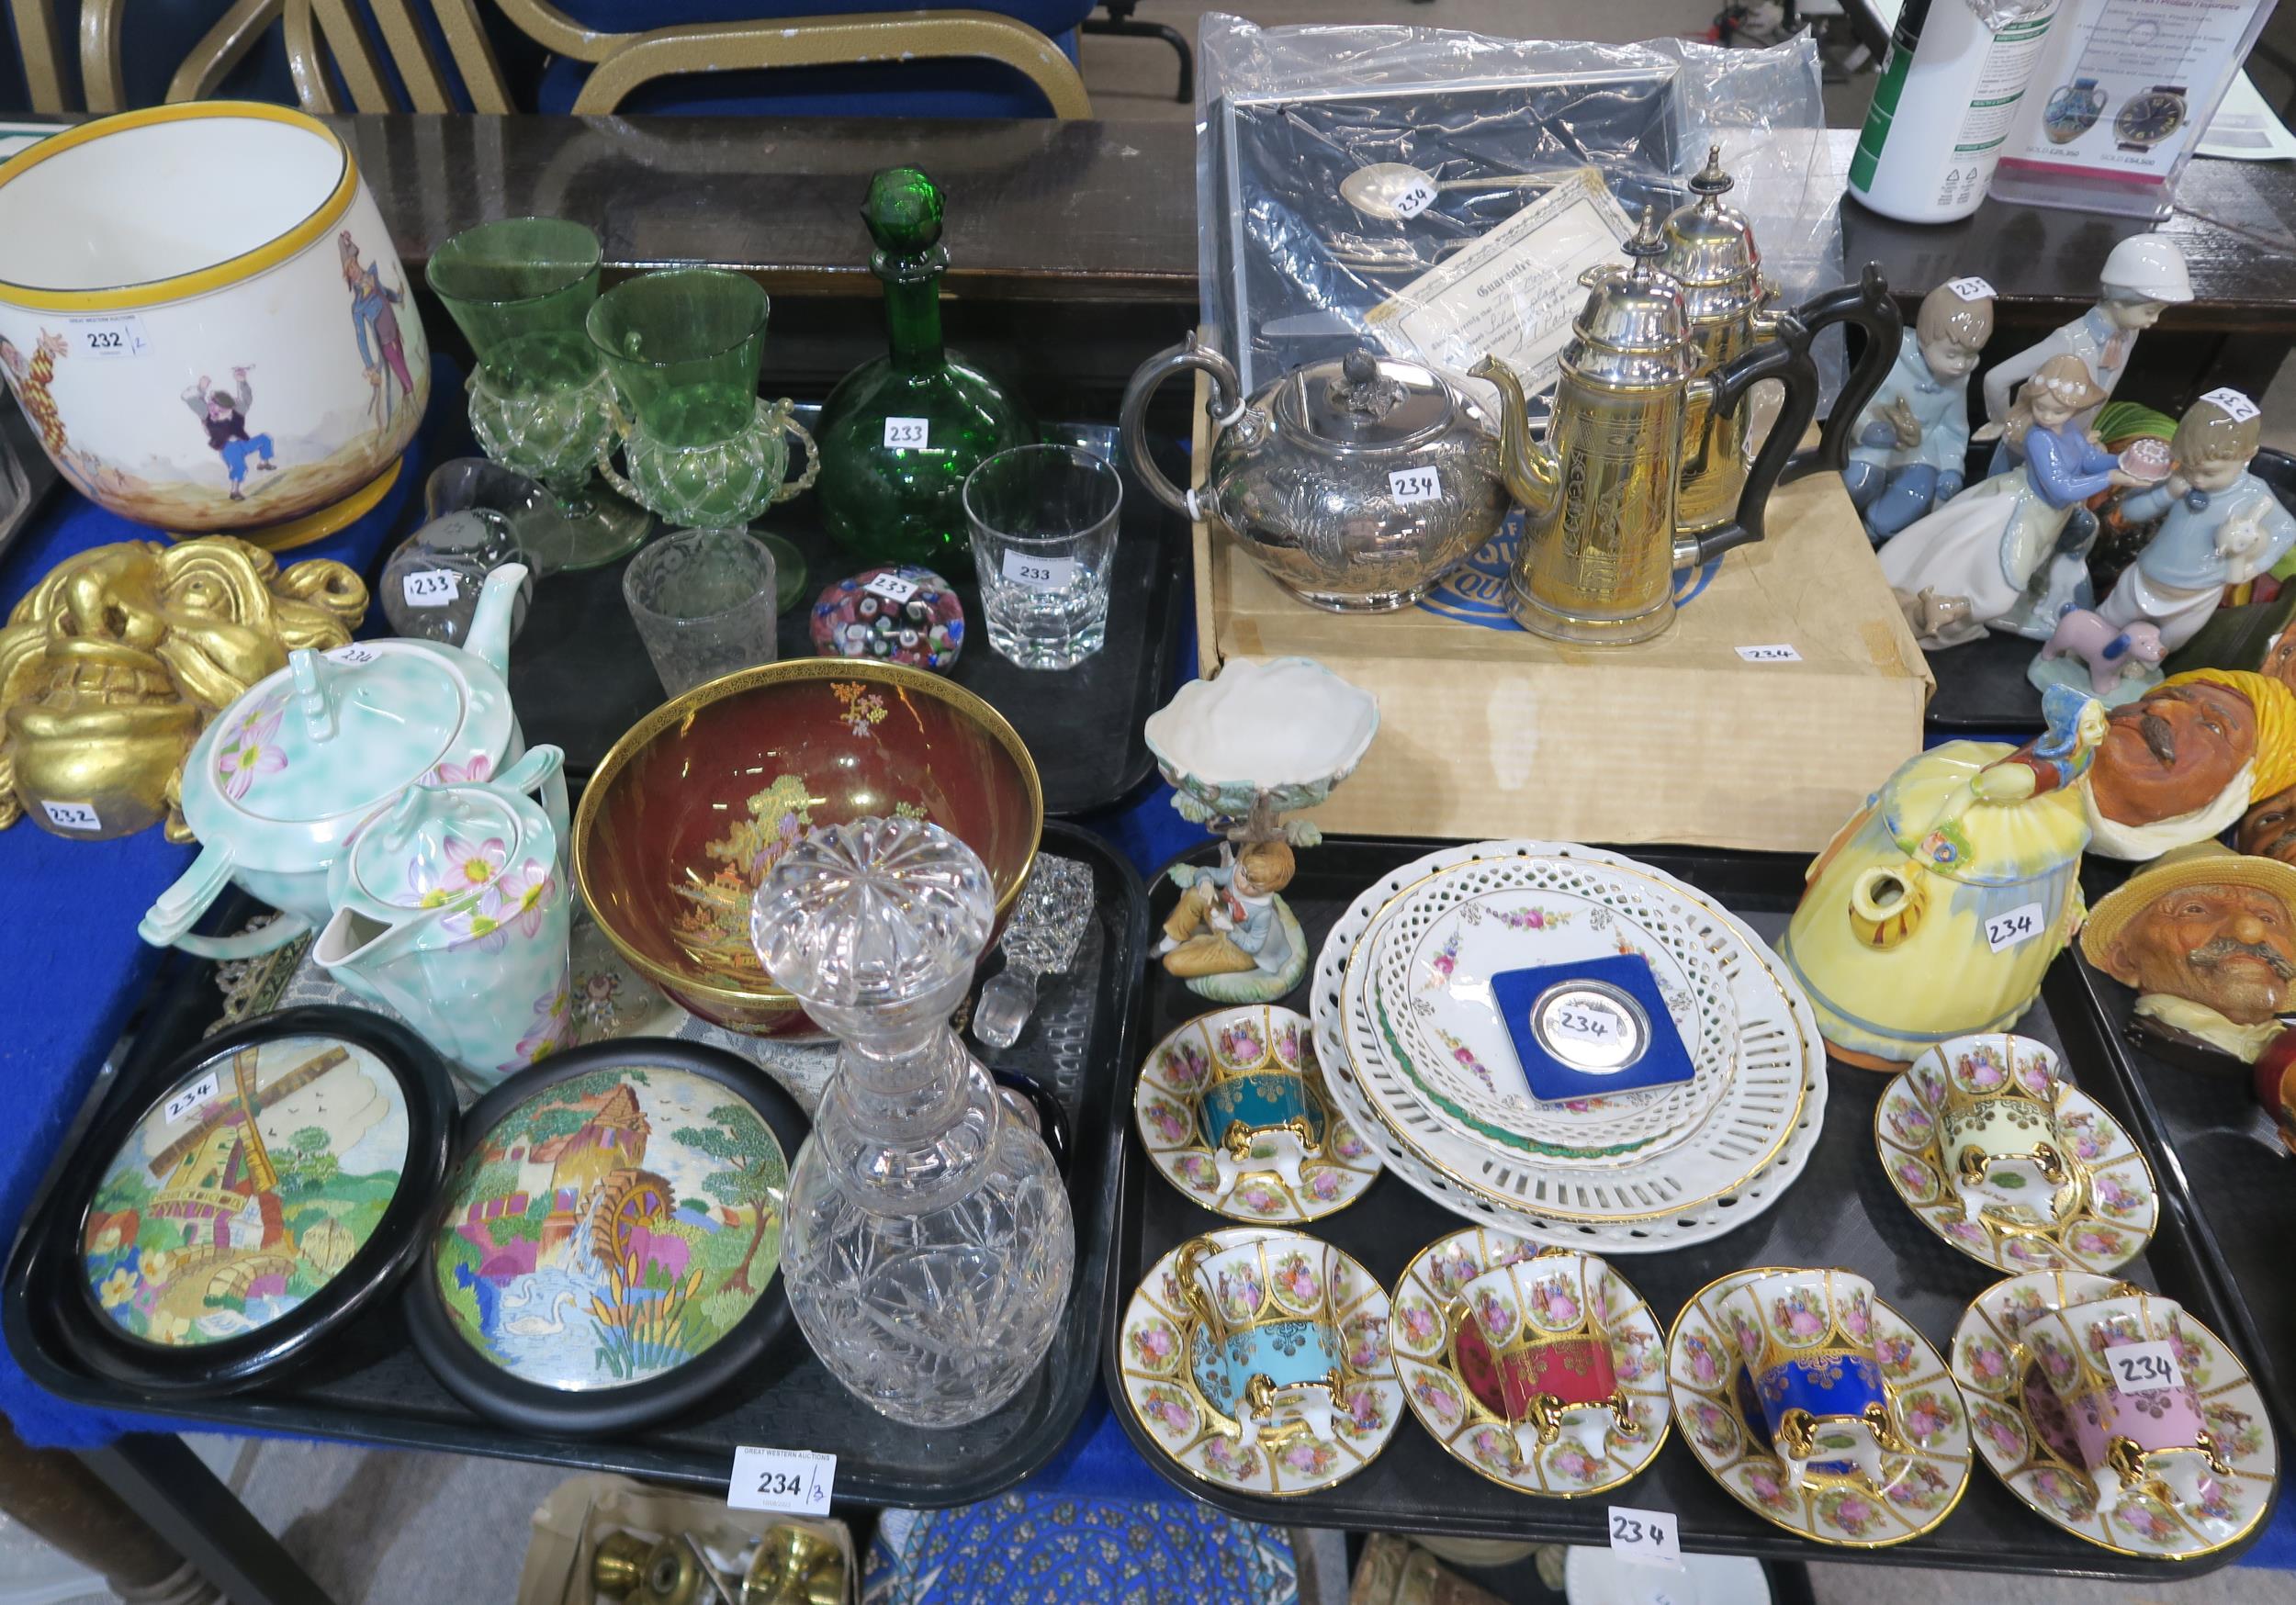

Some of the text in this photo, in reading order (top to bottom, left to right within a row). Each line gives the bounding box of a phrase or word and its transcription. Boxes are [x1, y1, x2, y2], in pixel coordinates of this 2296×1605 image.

[1398, 188, 1427, 211] 234
[87, 332, 122, 347] 232
[890, 425, 923, 442] 233
[1395, 477, 1433, 497] 234
[1020, 566, 1051, 580] 233
[414, 575, 449, 595] 233
[874, 578, 907, 594] 233
[50, 807, 96, 823] 232
[1989, 915, 2032, 944] 234
[1561, 1012, 1609, 1038] 234
[169, 1084, 211, 1116] 234
[2118, 1355, 2172, 1385] 234
[766, 1450, 797, 1458] WESTERN
[798, 1452, 830, 1462] AUCTIONS
[757, 1471, 801, 1496] 234
[1613, 1515, 1664, 1546] 234
